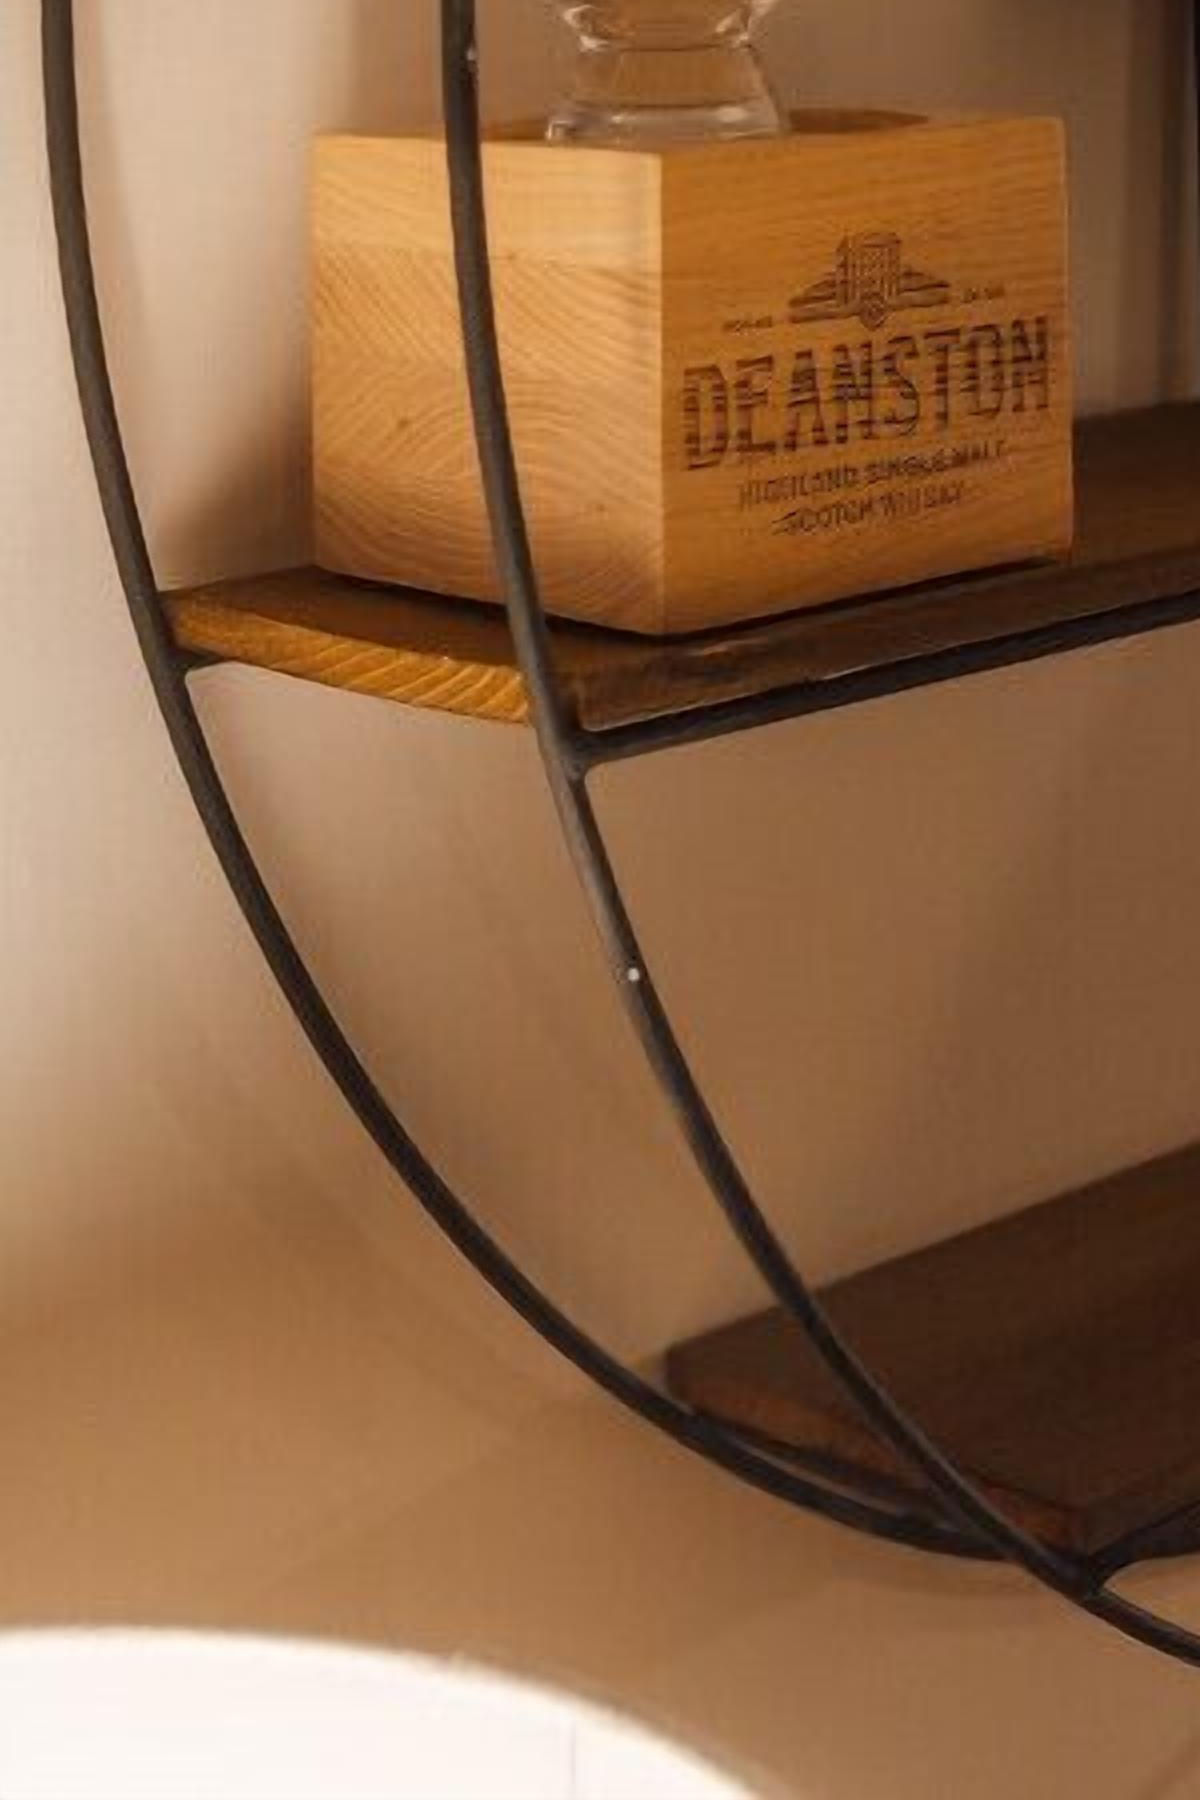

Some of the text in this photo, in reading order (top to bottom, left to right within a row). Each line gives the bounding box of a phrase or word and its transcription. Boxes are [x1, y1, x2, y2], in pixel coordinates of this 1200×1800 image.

[682, 315, 1049, 471] DEANSTON
[738, 461, 858, 510] HIGHLAND
[773, 479, 966, 535] SCOTCH WHISKY
